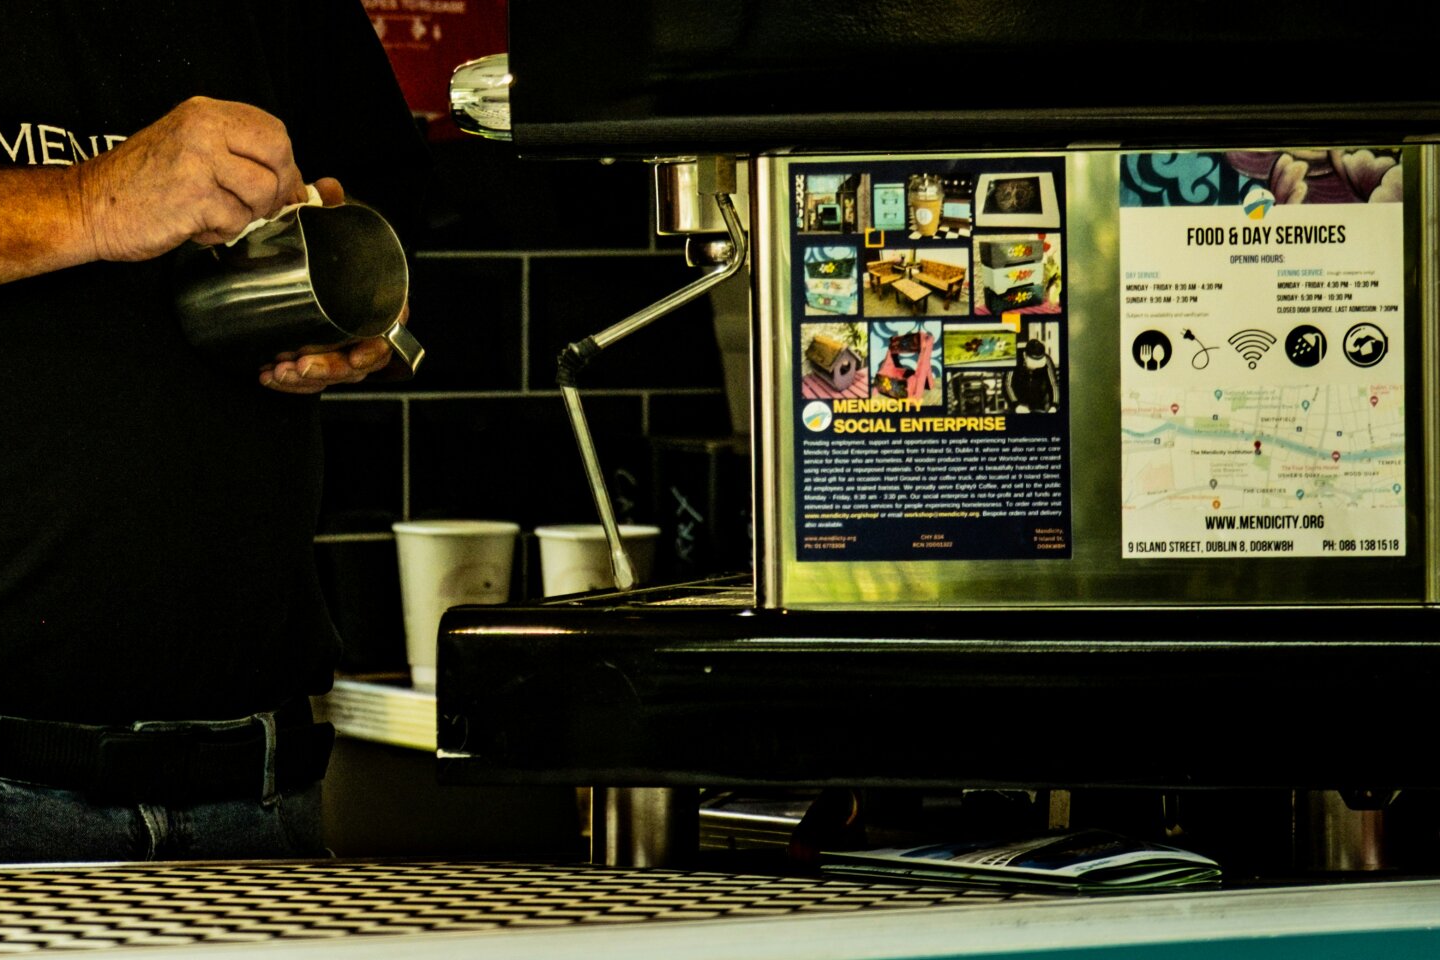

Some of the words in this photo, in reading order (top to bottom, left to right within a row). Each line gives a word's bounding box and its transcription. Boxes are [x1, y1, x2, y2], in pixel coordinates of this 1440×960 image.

[1187, 227, 1224, 245] FOOD
[1229, 227, 1238, 245] &
[1242, 226, 1272, 245] DAY
[1276, 225, 1346, 244] SERVICES
[1230, 255, 1259, 264] OPENING
[1261, 254, 1285, 263] HOURS:
[833, 398, 923, 413] MENDICITY
[834, 418, 896, 433] SOCIAL
[900, 416, 1006, 432] ENTERPRISE
[1205, 515, 1324, 530] WWW.MENDICITY.ORG
[1128, 542, 1134, 553] 9
[1136, 542, 1166, 552] ISLAND
[1169, 542, 1203, 553] STREET,
[1206, 541, 1237, 552] DUBLIN
[1239, 541, 1248, 552] 8,
[1323, 540, 1337, 551] PH:
[1339, 540, 1356, 551] 086
